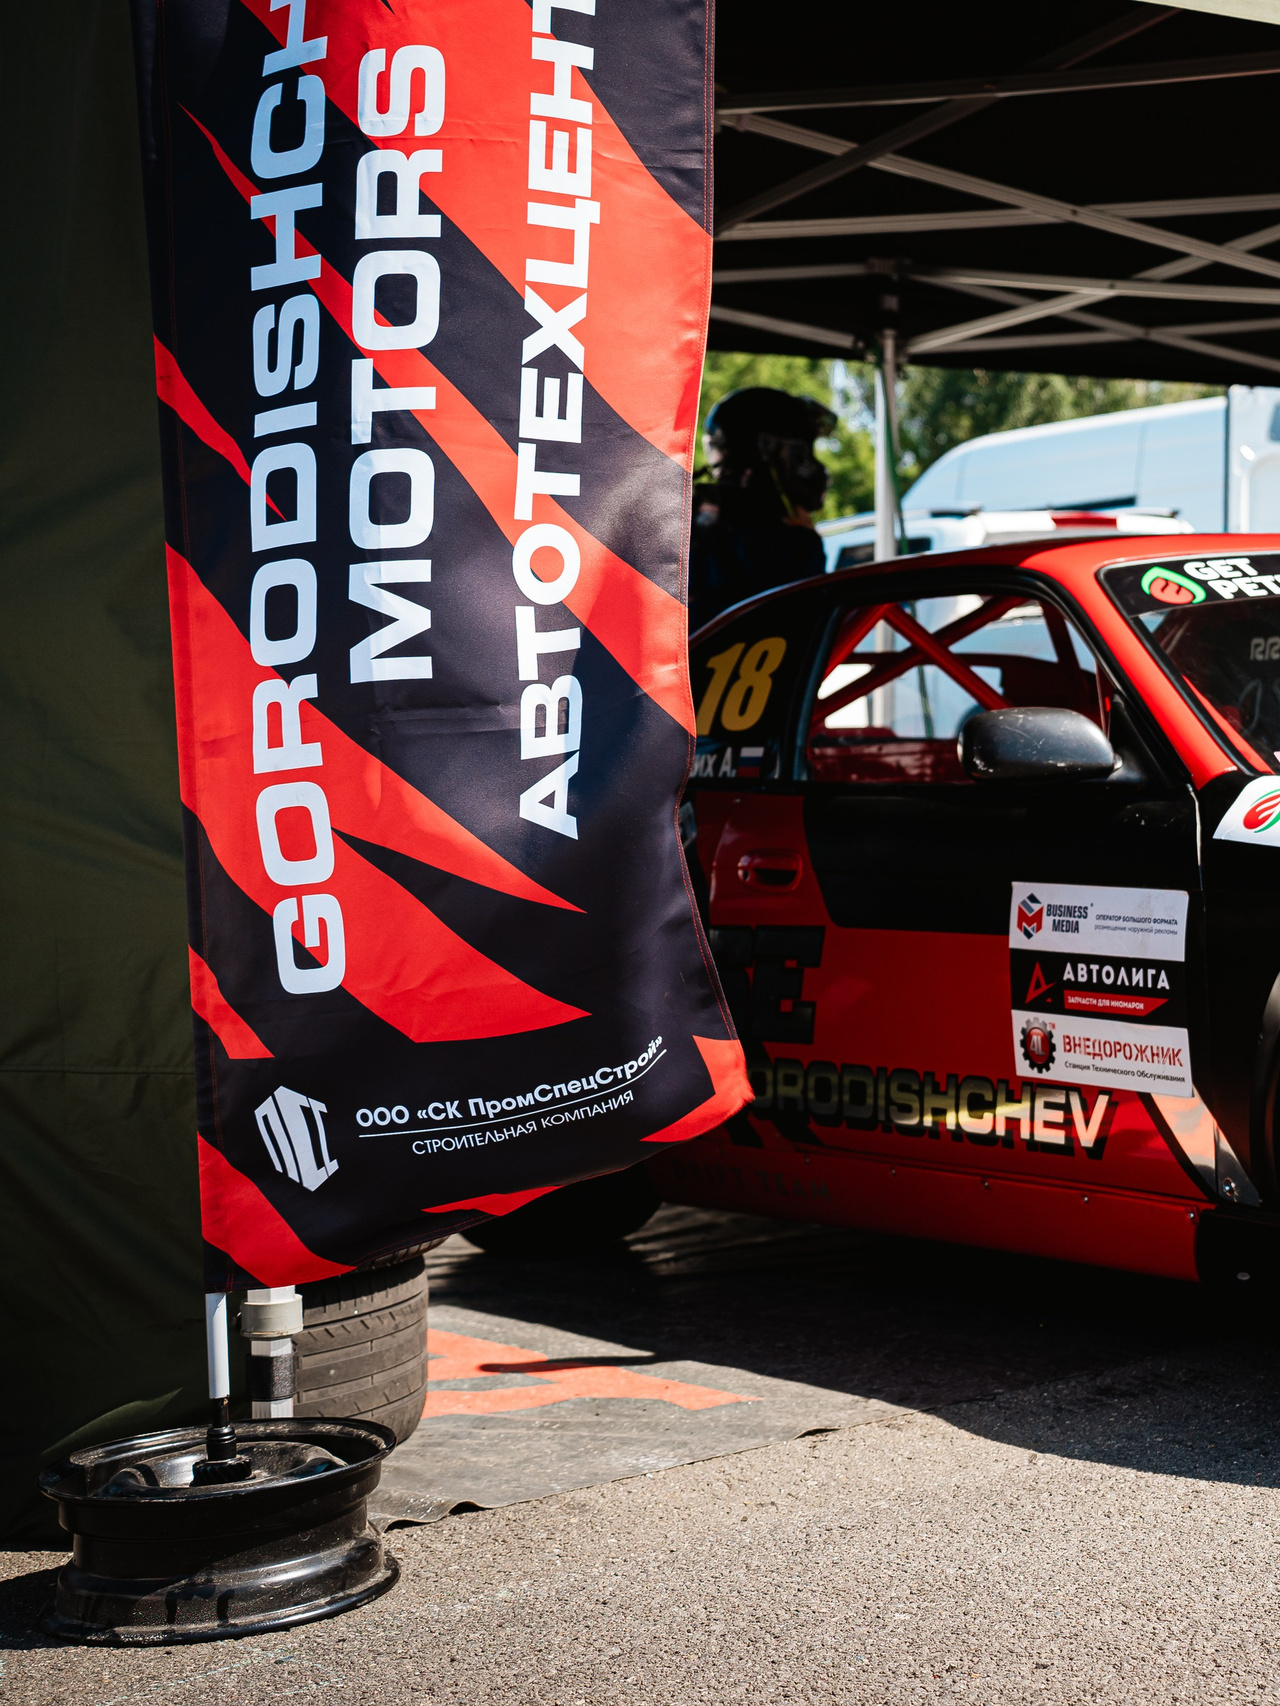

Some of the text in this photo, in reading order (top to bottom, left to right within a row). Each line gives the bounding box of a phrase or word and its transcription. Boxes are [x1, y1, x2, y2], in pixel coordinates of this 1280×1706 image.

[347, 44, 446, 684] MOTORS
[1183, 557, 1259, 581] GET
[697, 636, 788, 732] 18
[1046, 903, 1089, 919] BUSINESS
[1095, 913, 1178, 926] ОПЕРАТОР БОЛЬШОГО ФОРМАТА
[1051, 918, 1080, 934] MEDIA
[1062, 962, 1171, 990] АВТОЛИГА
[1067, 995, 1145, 1011] ЗАПЧАСТИ ДЛЯ ИНОМАРОК
[1062, 1034, 1183, 1068] ВНЕДОРОЖНИК
[355, 1035, 664, 1128] ООО «СК ПромСпецСтрой»
[1064, 1060, 1186, 1083] Станция Технического Обслуживания
[749, 1062, 1112, 1151] ORODISHCHEV
[411, 1089, 635, 1156] СТРОИТЕЛЬНАЯ КОМПАНИЯ
